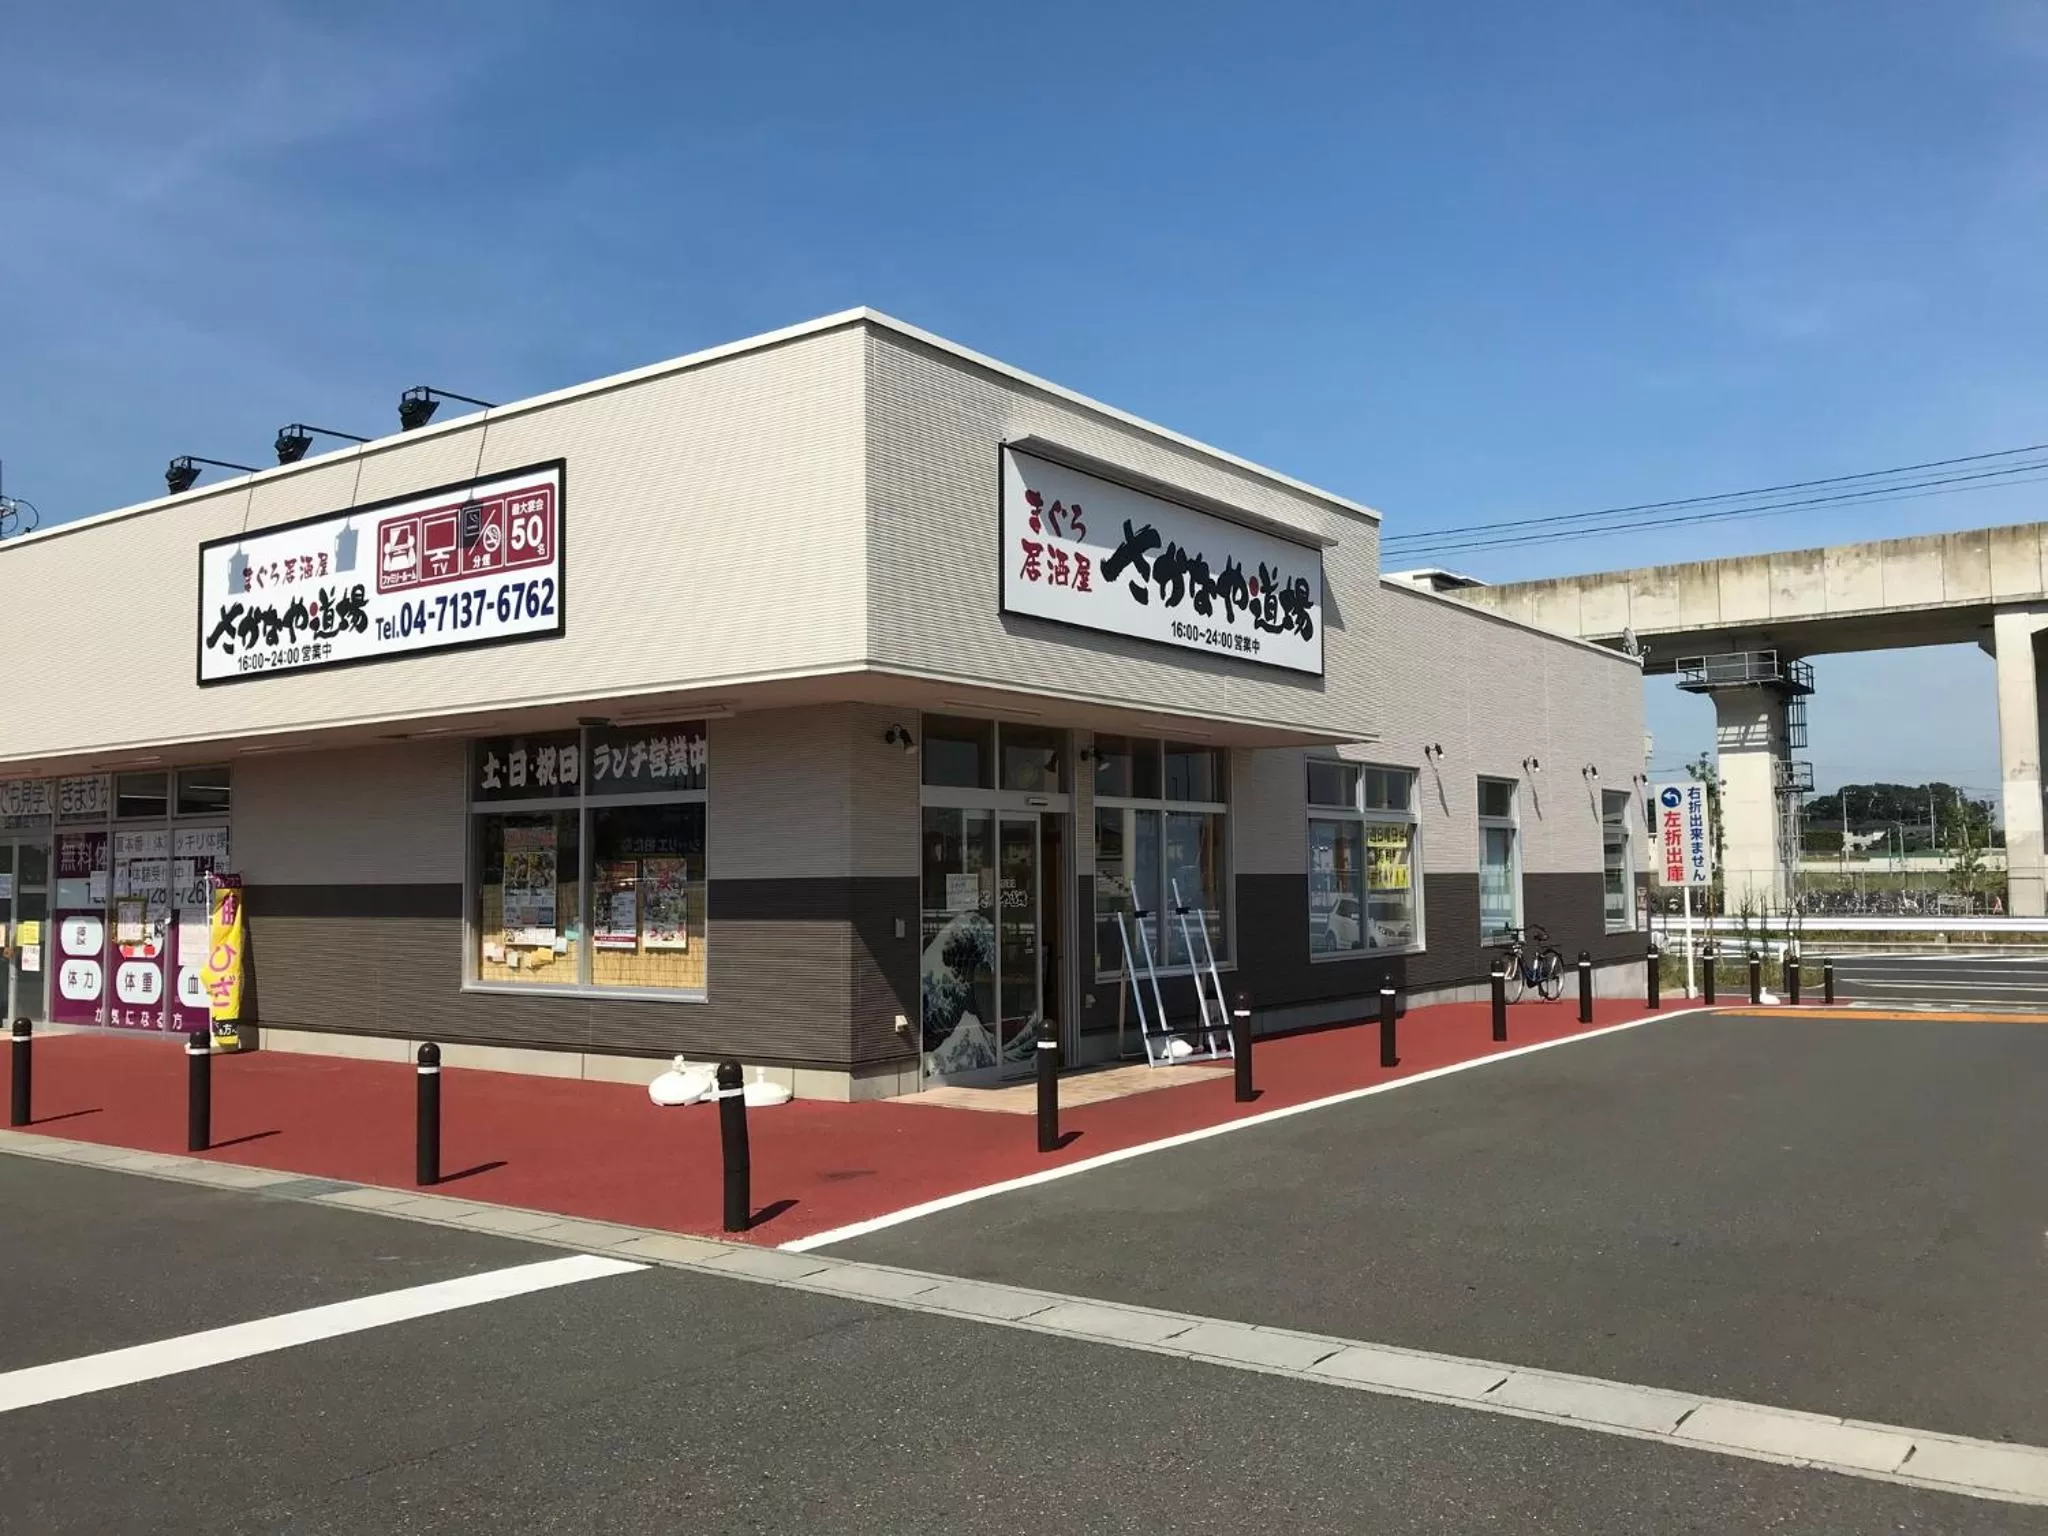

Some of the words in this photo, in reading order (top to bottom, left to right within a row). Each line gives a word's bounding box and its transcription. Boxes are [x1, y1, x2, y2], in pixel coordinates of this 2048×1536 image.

[511, 514, 544, 551] 50
[1025, 489, 1087, 543] まぐろ
[432, 562, 449, 576] TV
[1020, 537, 1092, 593] 居酒屋
[1100, 518, 1314, 642] さかなや道場
[206, 584, 369, 655] さかなや道場
[1663, 811, 1684, 882] 左折出庫
[1687, 786, 1705, 882] 右折出来ません
[67, 965, 95, 989] 体力
[124, 972, 153, 993] 体重
